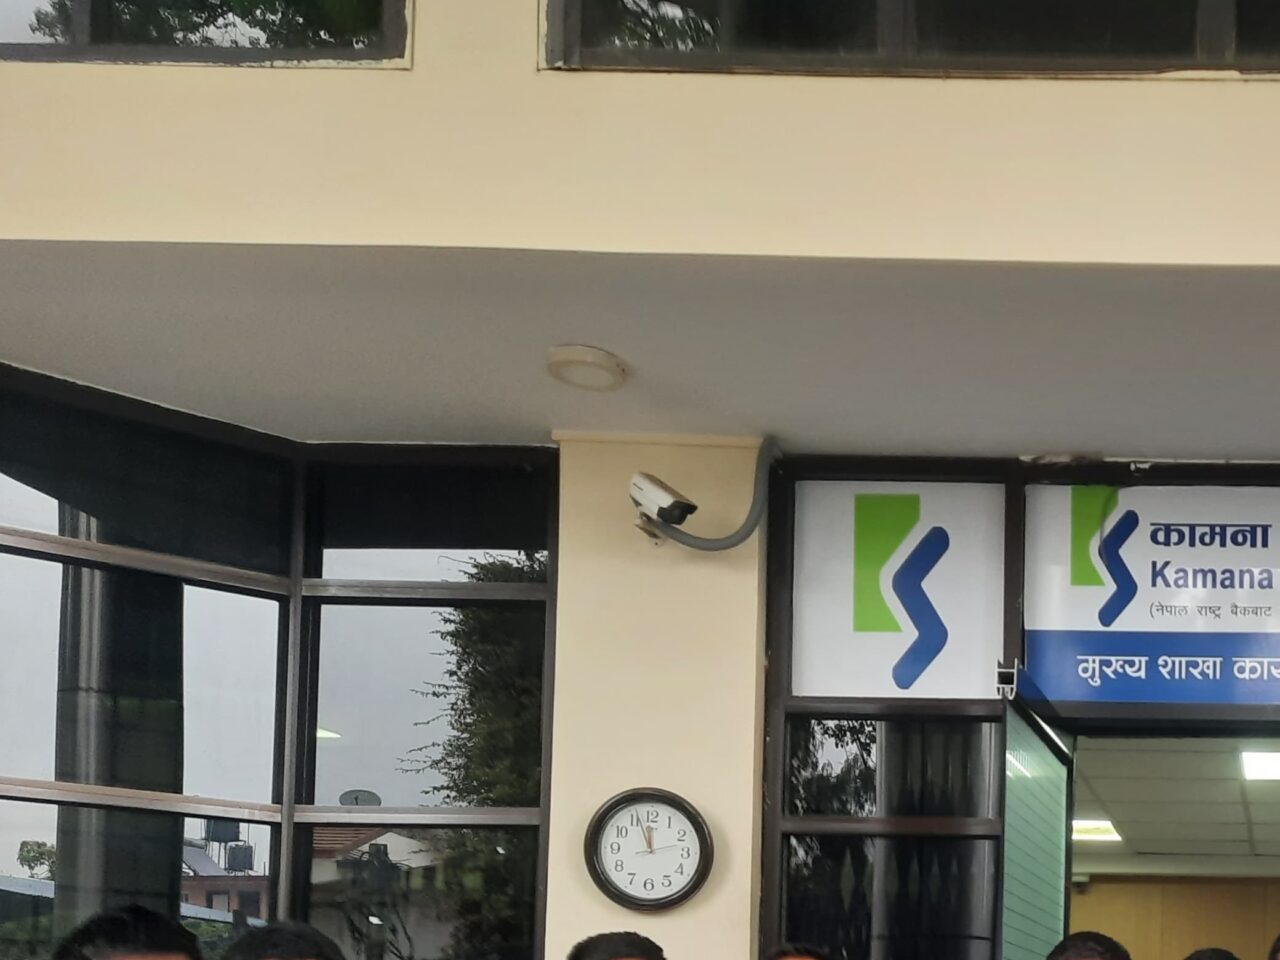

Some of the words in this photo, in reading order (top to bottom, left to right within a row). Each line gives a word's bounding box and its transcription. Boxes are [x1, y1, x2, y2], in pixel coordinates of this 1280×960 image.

[1150, 522, 1272, 548] कामना
[1150, 560, 1274, 589] Kamana
[1150, 602, 1189, 619] (नेपाल
[1077, 655, 1149, 687] मुख्य
[1158, 655, 1223, 680] शाखा
[645, 810, 659, 823] 12
[667, 816, 672, 829] 1
[616, 825, 628, 838] 10
[677, 829, 687, 842] 2
[610, 842, 621, 854] 9
[681, 847, 691, 859] 3
[614, 859, 624, 872] 8
[674, 862, 684, 876] 4
[627, 873, 636, 885] 7
[643, 878, 655, 891] 6
[661, 875, 672, 887] 5
